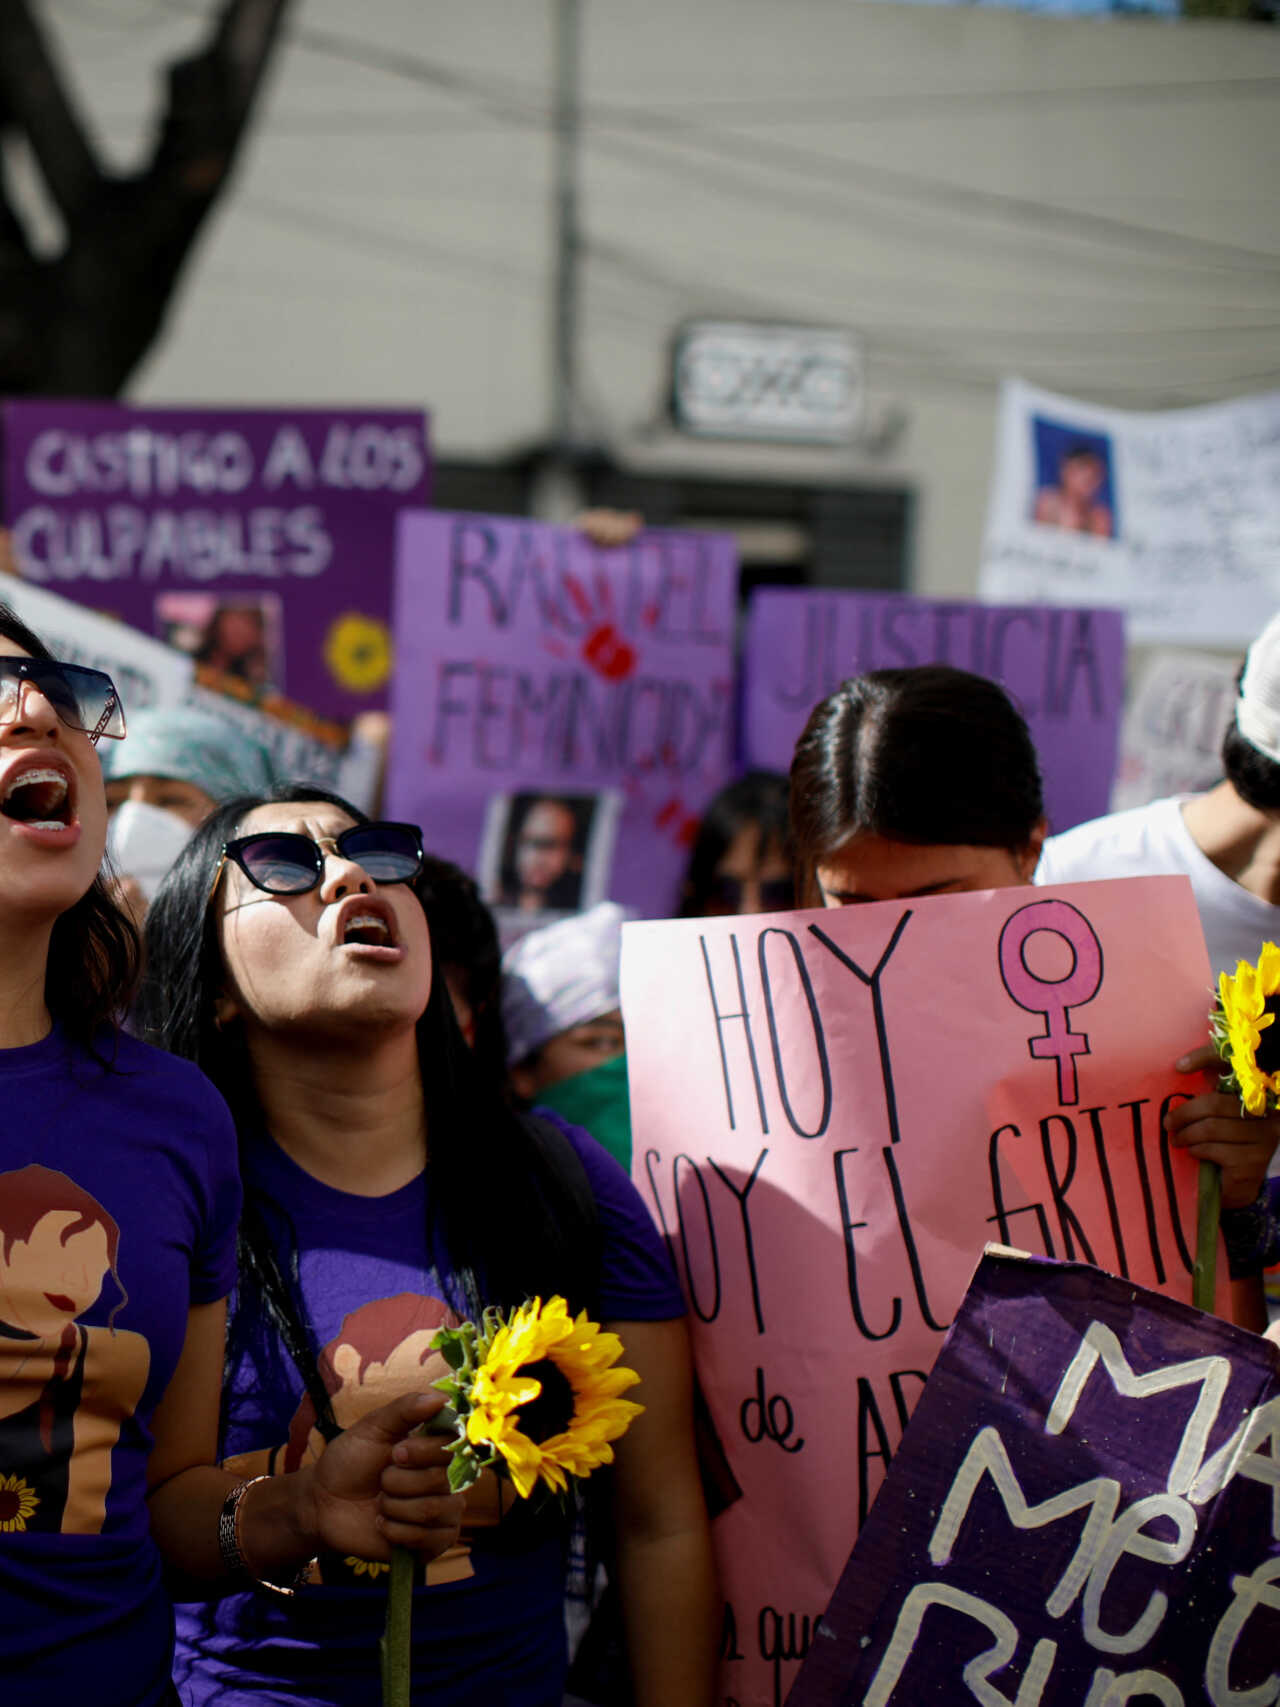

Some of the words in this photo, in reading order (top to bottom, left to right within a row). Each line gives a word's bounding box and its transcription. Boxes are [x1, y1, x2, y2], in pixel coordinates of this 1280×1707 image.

[26, 424, 254, 498] CASTIGO
[265, 424, 318, 491] A
[322, 421, 423, 493] LOS
[15, 504, 333, 582] CULPABLES
[776, 598, 1106, 716] JUSTICIA
[698, 908, 914, 1145] HOY
[644, 1146, 770, 1336] SOY
[833, 1145, 952, 1343] EL
[739, 1366, 806, 1453] de
